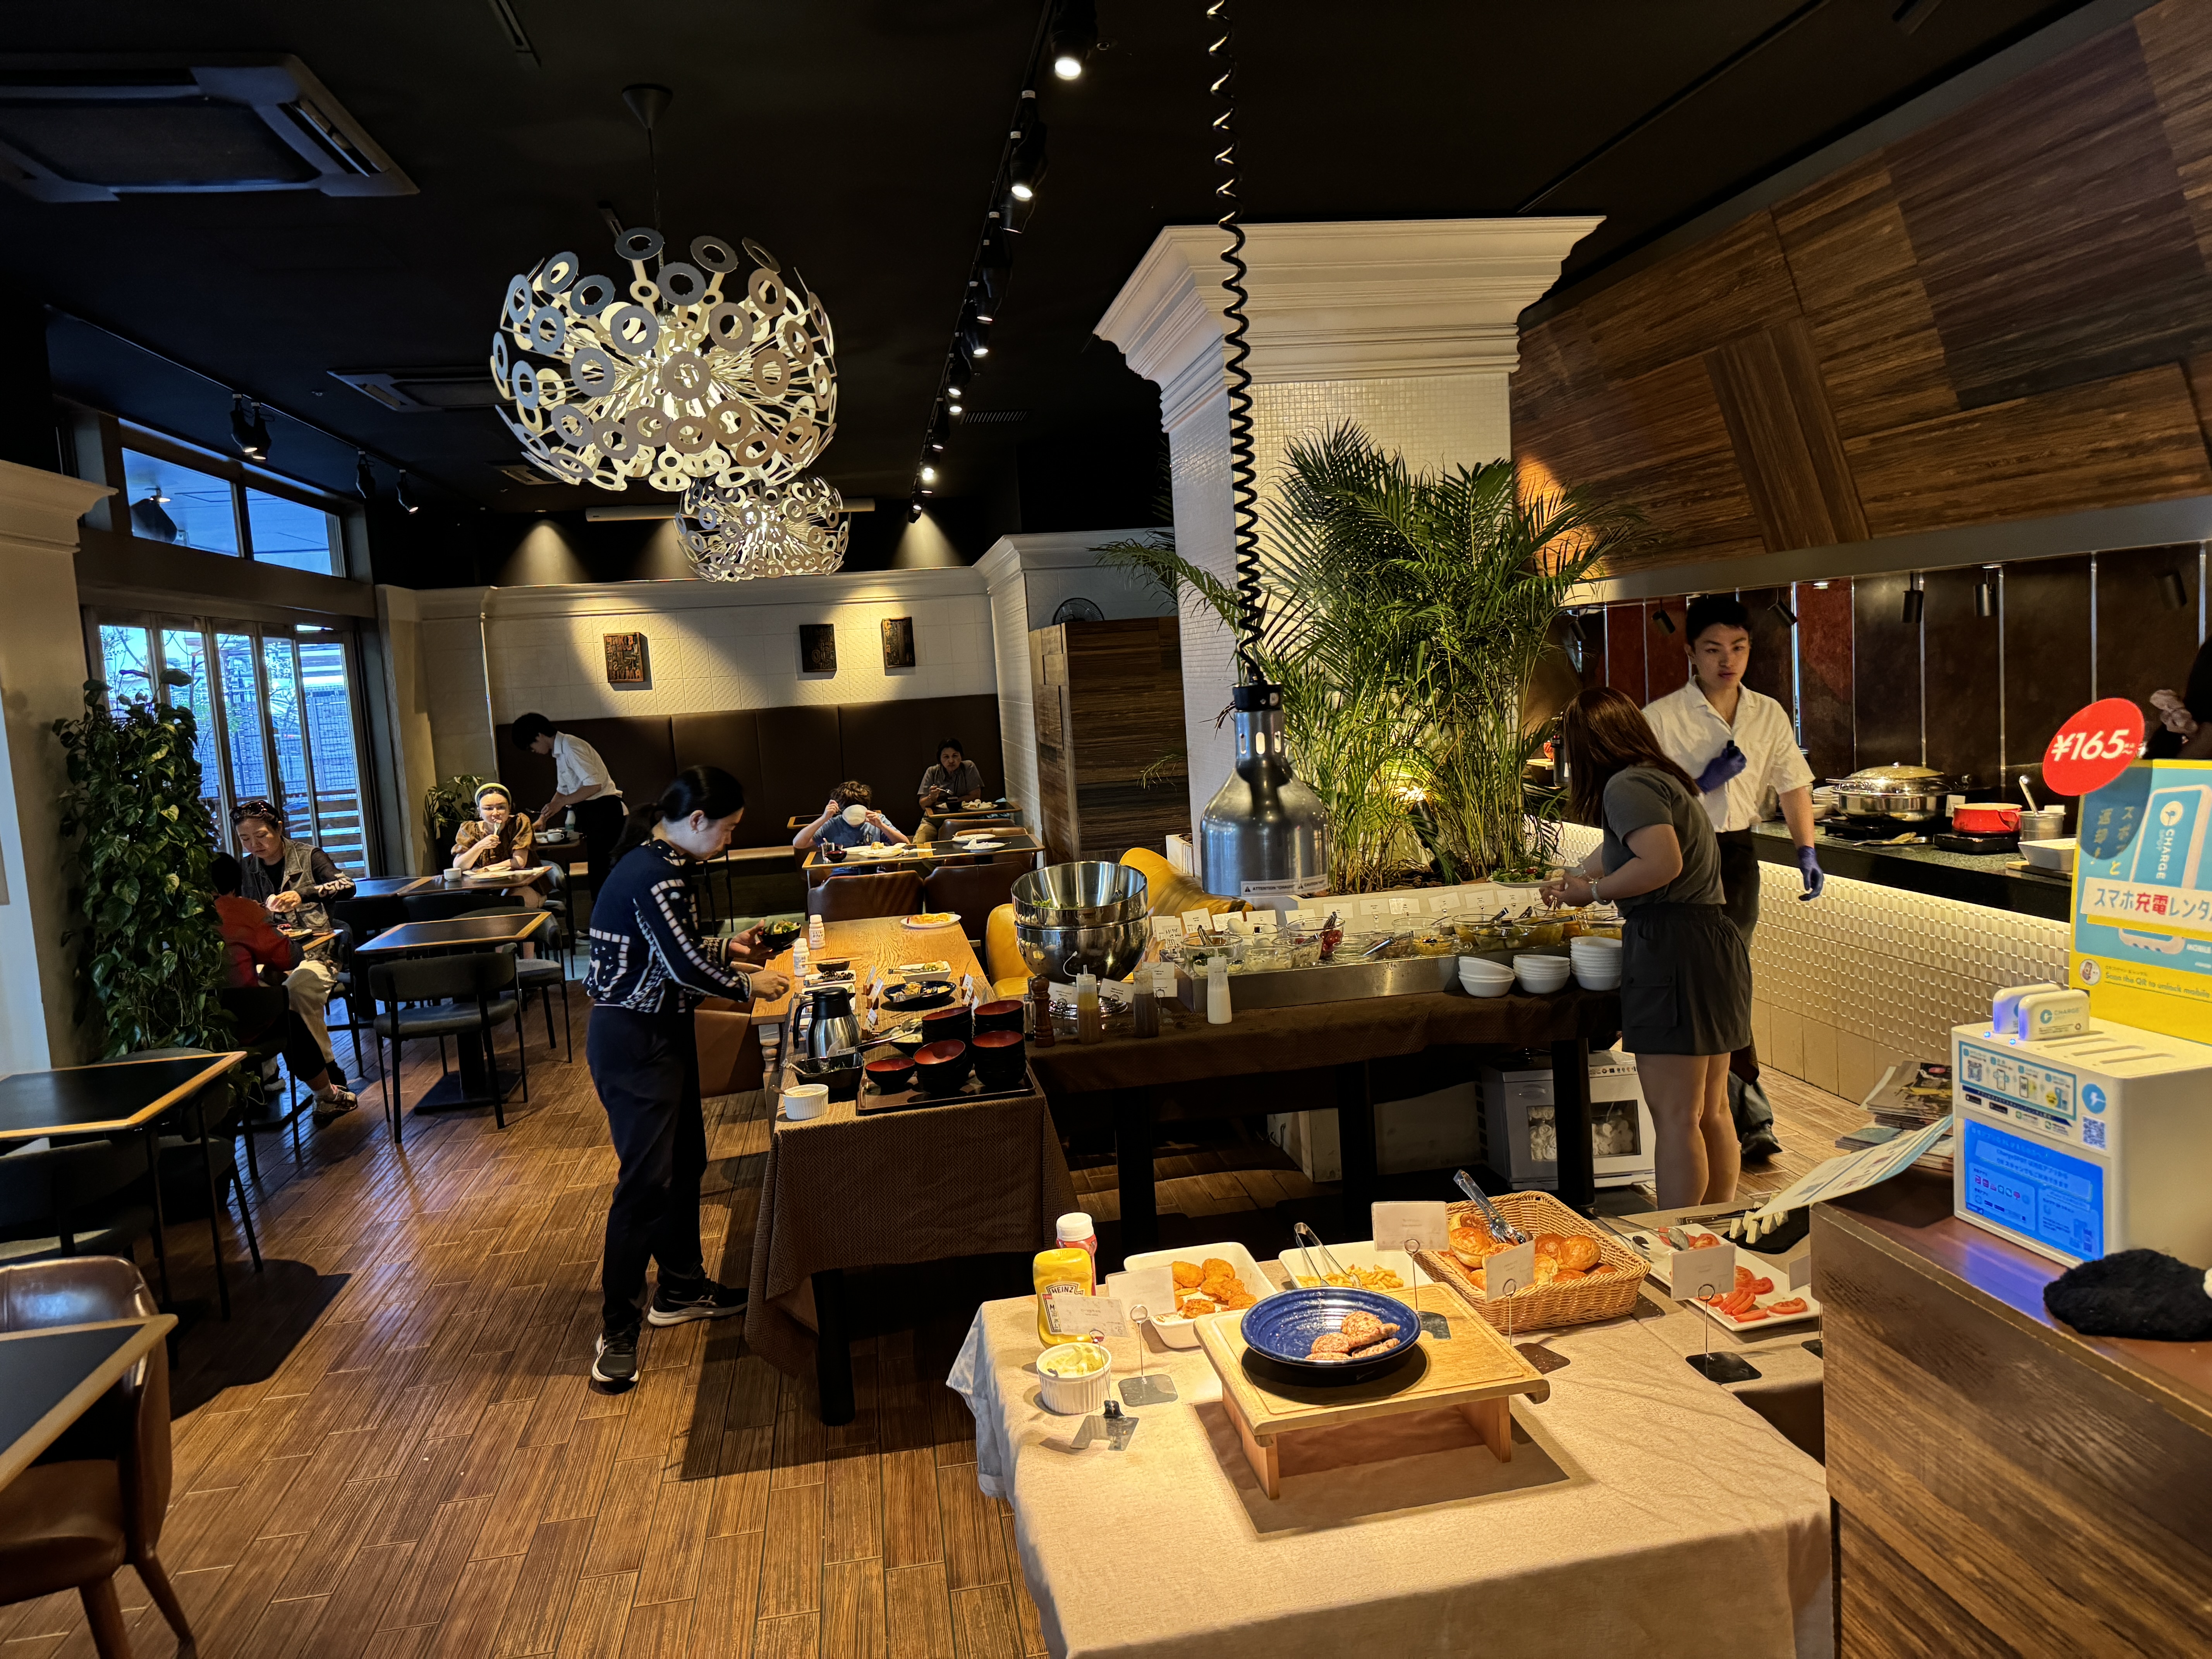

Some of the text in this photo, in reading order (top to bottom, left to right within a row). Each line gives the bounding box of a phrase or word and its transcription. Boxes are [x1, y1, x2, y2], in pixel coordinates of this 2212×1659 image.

[2156, 828, 2175, 879] CHARGE
[2095, 888, 2212, 922] スマホ充電レンタ
